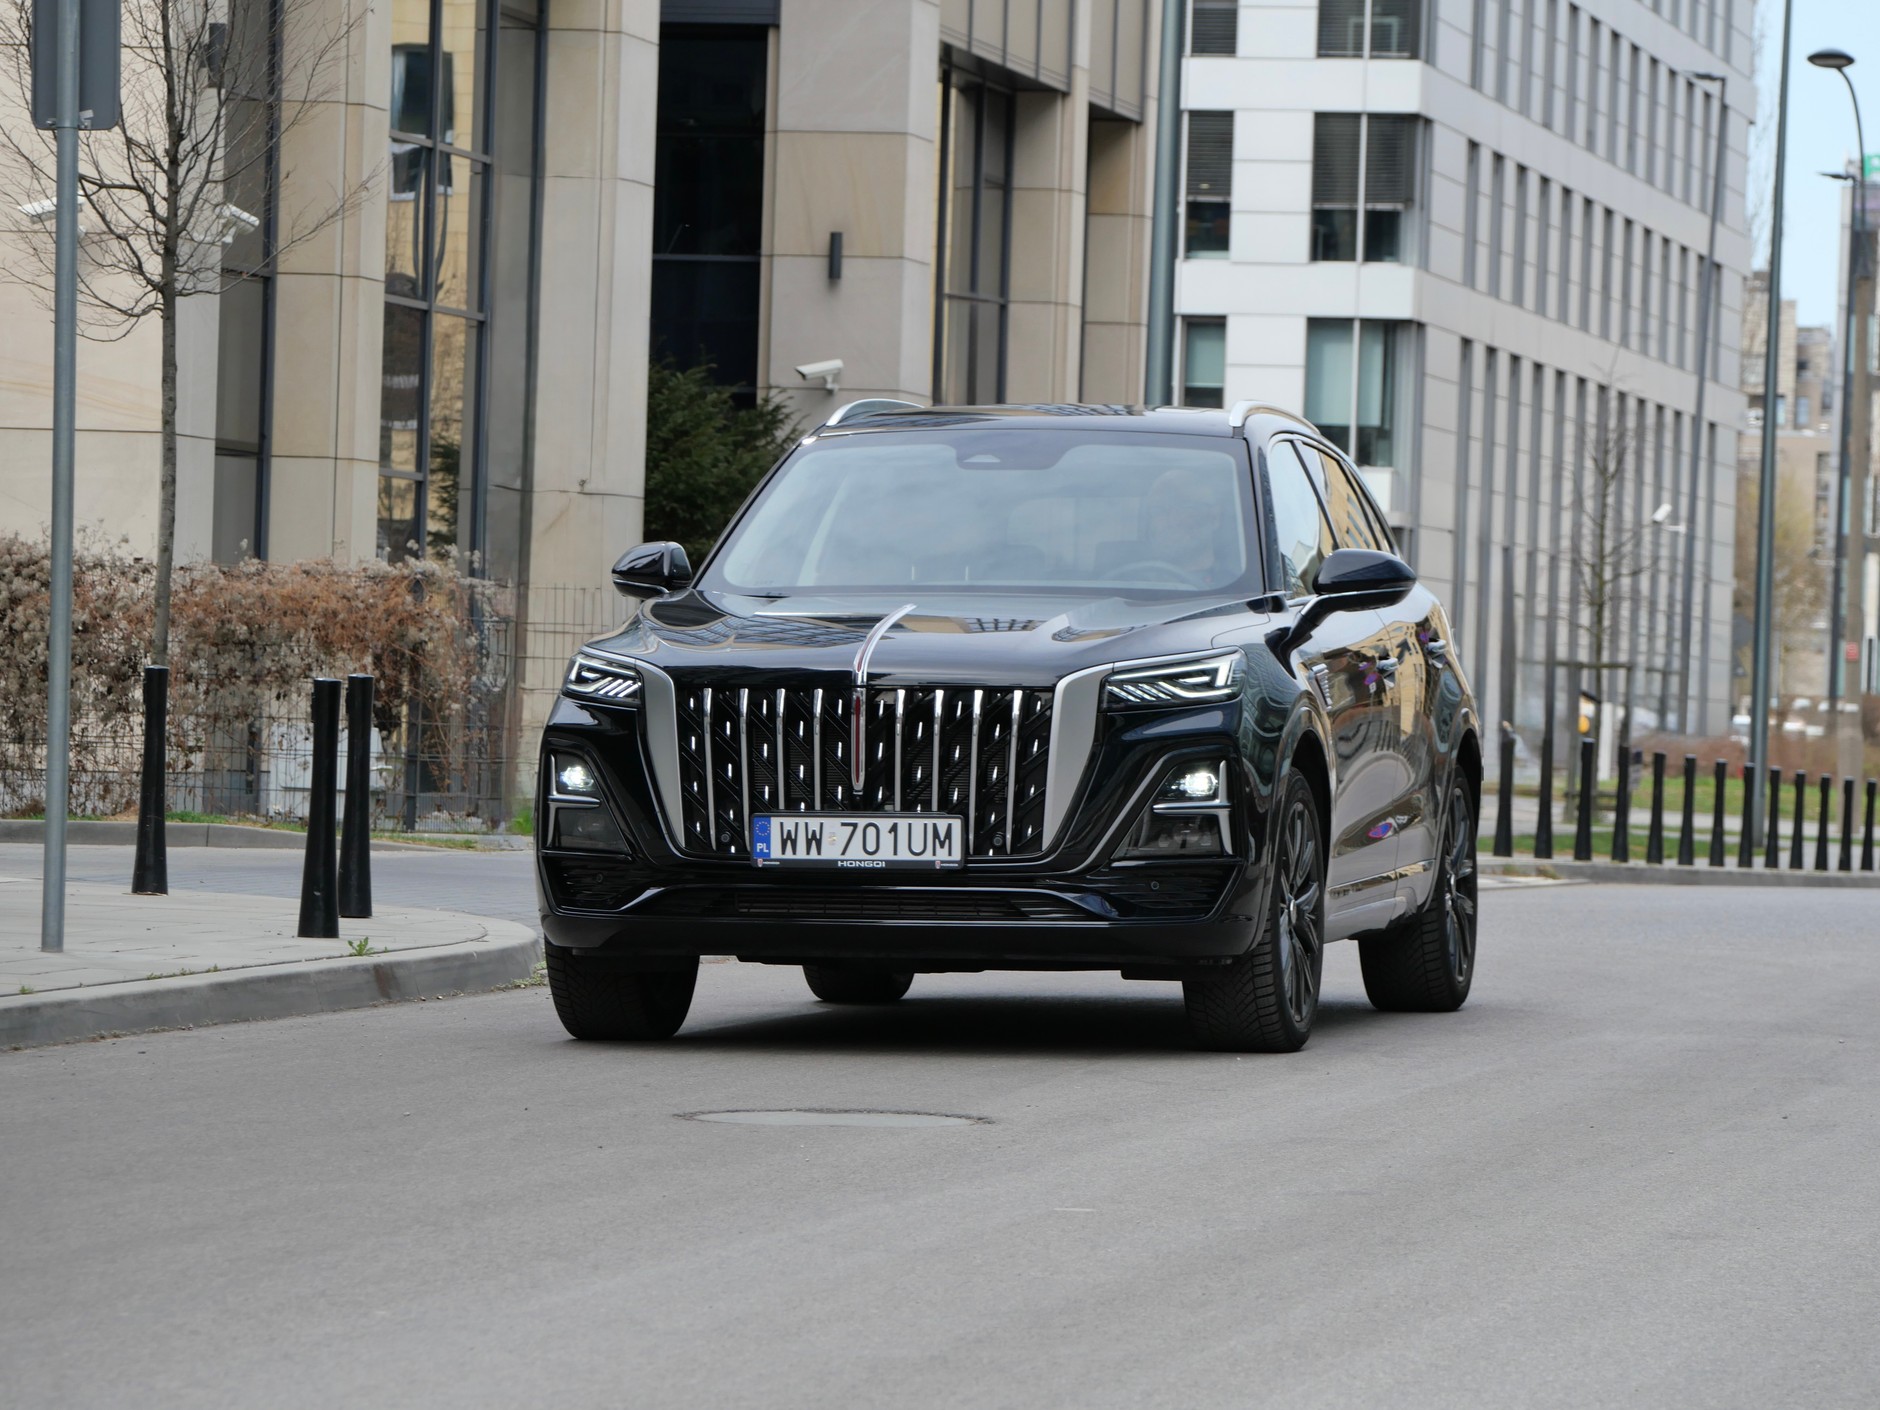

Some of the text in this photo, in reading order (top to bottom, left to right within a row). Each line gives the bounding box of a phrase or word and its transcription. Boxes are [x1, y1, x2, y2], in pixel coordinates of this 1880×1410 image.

[756, 843, 769, 853] PL
[780, 821, 952, 857] WW 701UM
